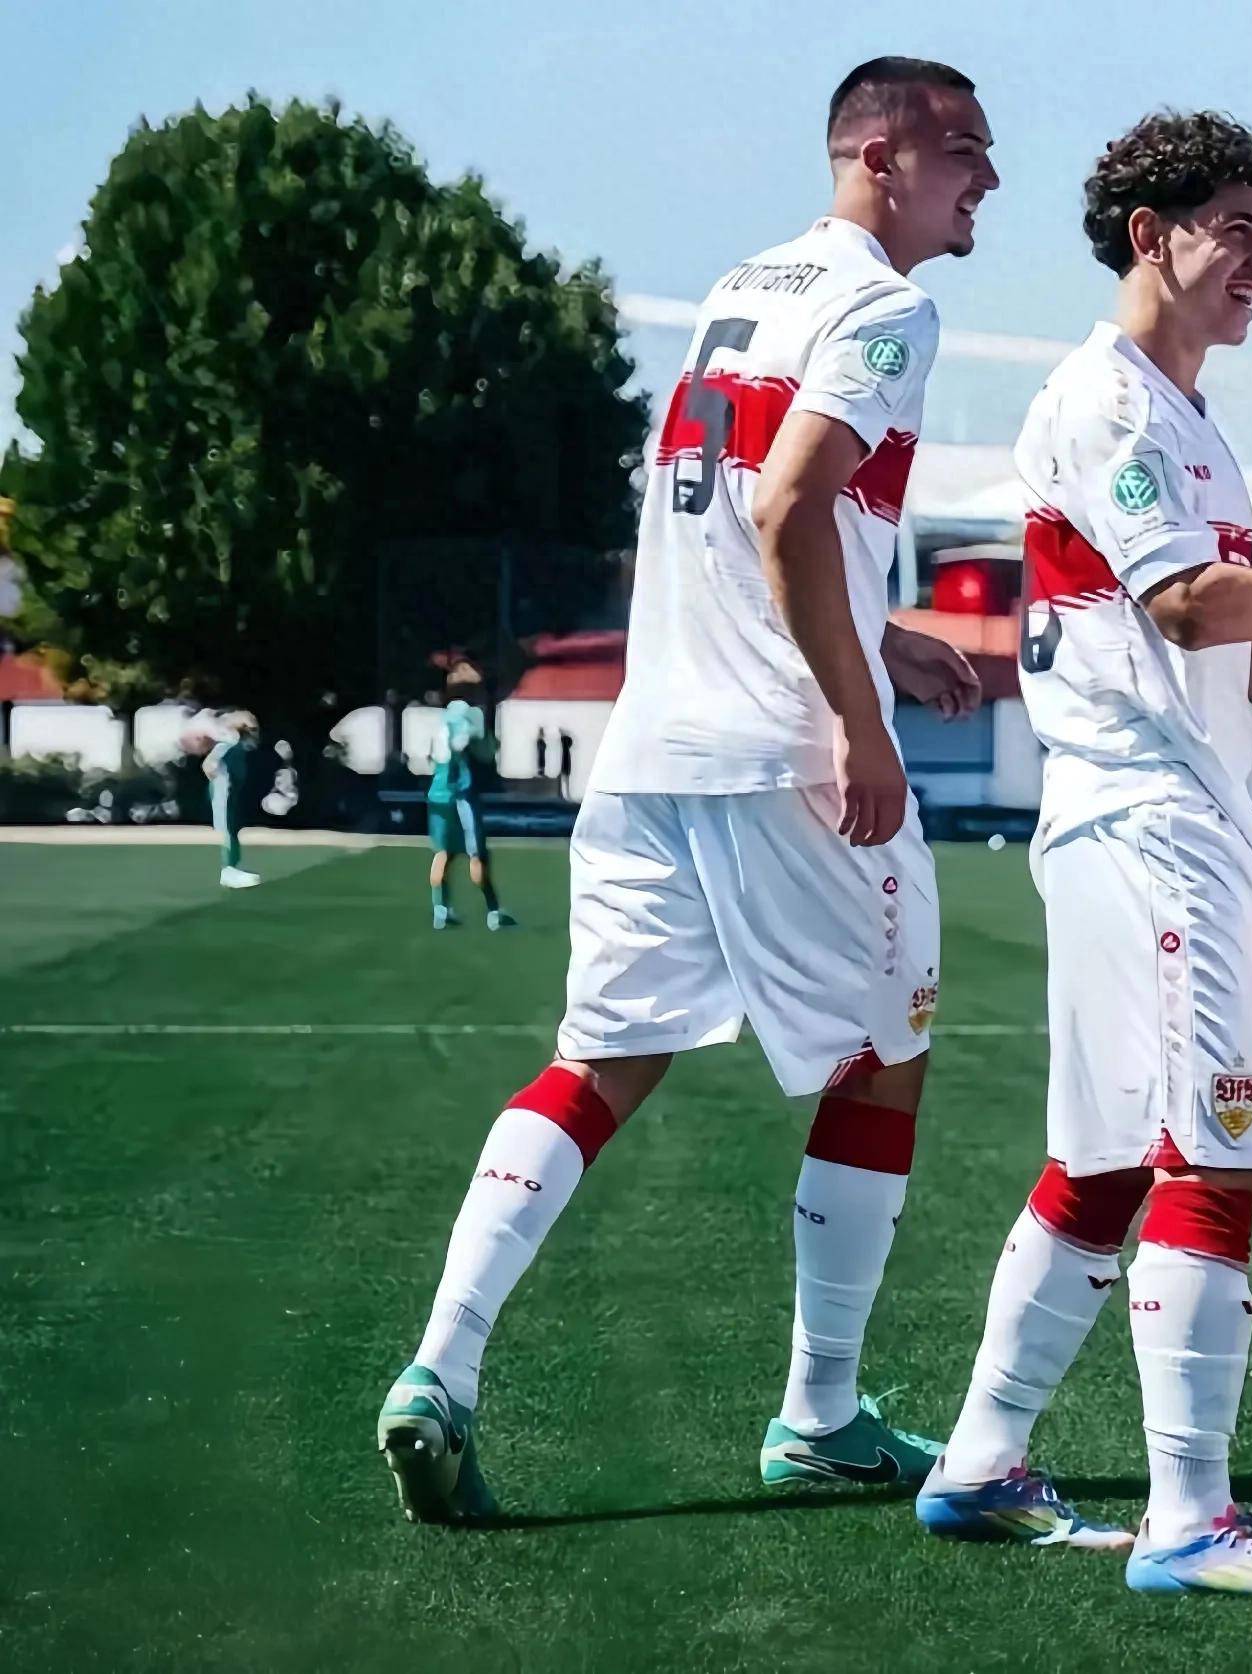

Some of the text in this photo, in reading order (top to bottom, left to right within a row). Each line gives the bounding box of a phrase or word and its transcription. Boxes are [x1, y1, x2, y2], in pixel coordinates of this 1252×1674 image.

[673, 317, 759, 516] 5
[477, 1168, 542, 1192] AKO
[1131, 1300, 1161, 1312] KO
